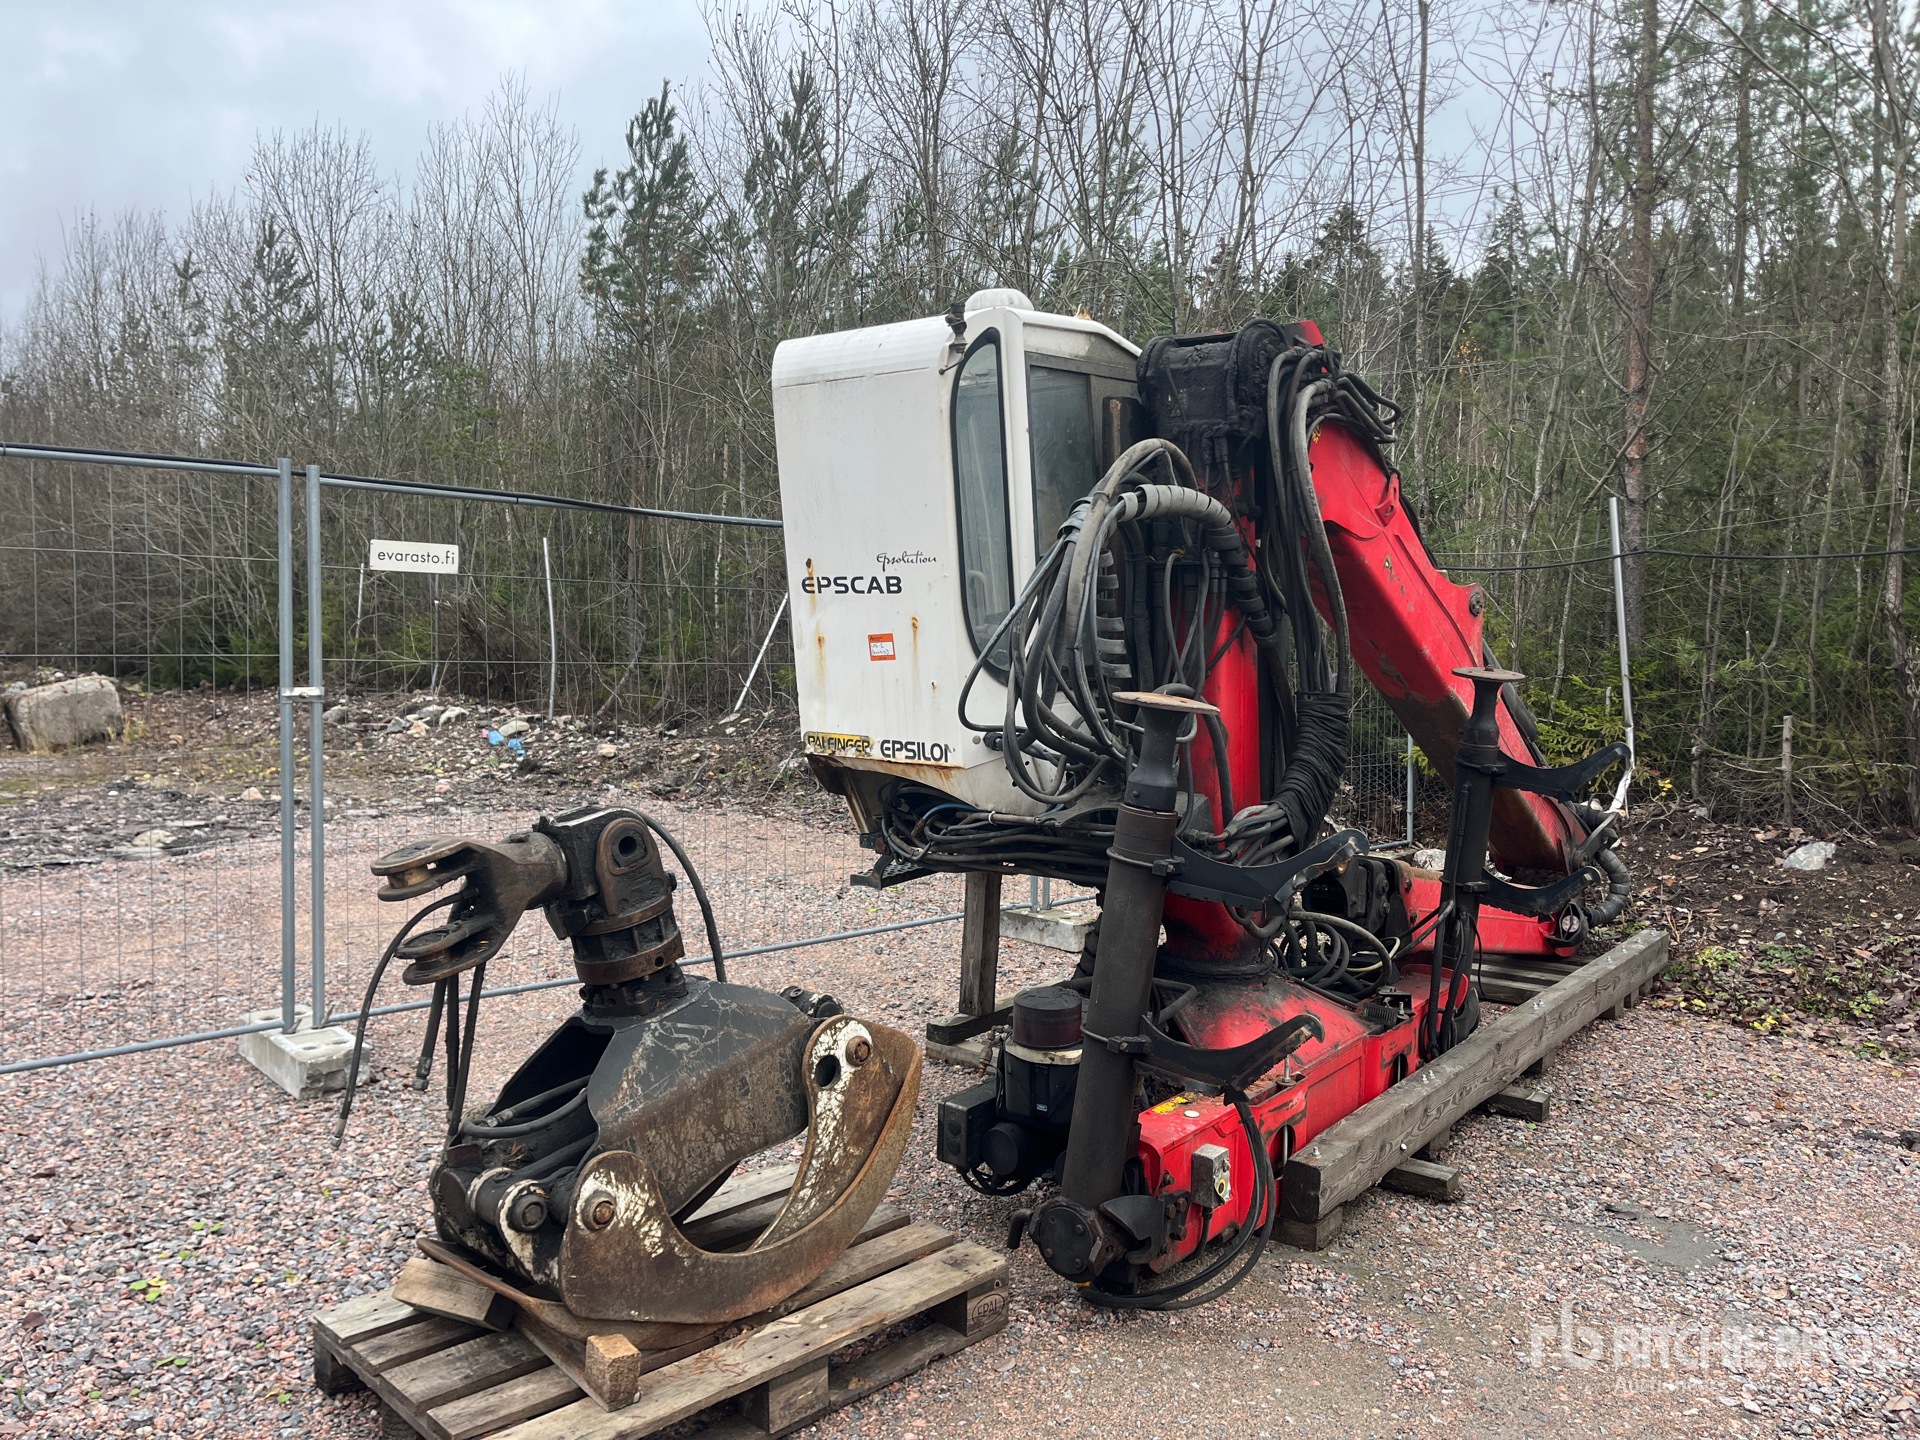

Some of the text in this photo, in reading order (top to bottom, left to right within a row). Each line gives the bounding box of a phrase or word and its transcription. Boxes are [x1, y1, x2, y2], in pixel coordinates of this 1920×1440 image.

[377, 550, 455, 565] evarasto.fi
[876, 550, 937, 573] Epsolution
[801, 575, 903, 595] EPSCAB
